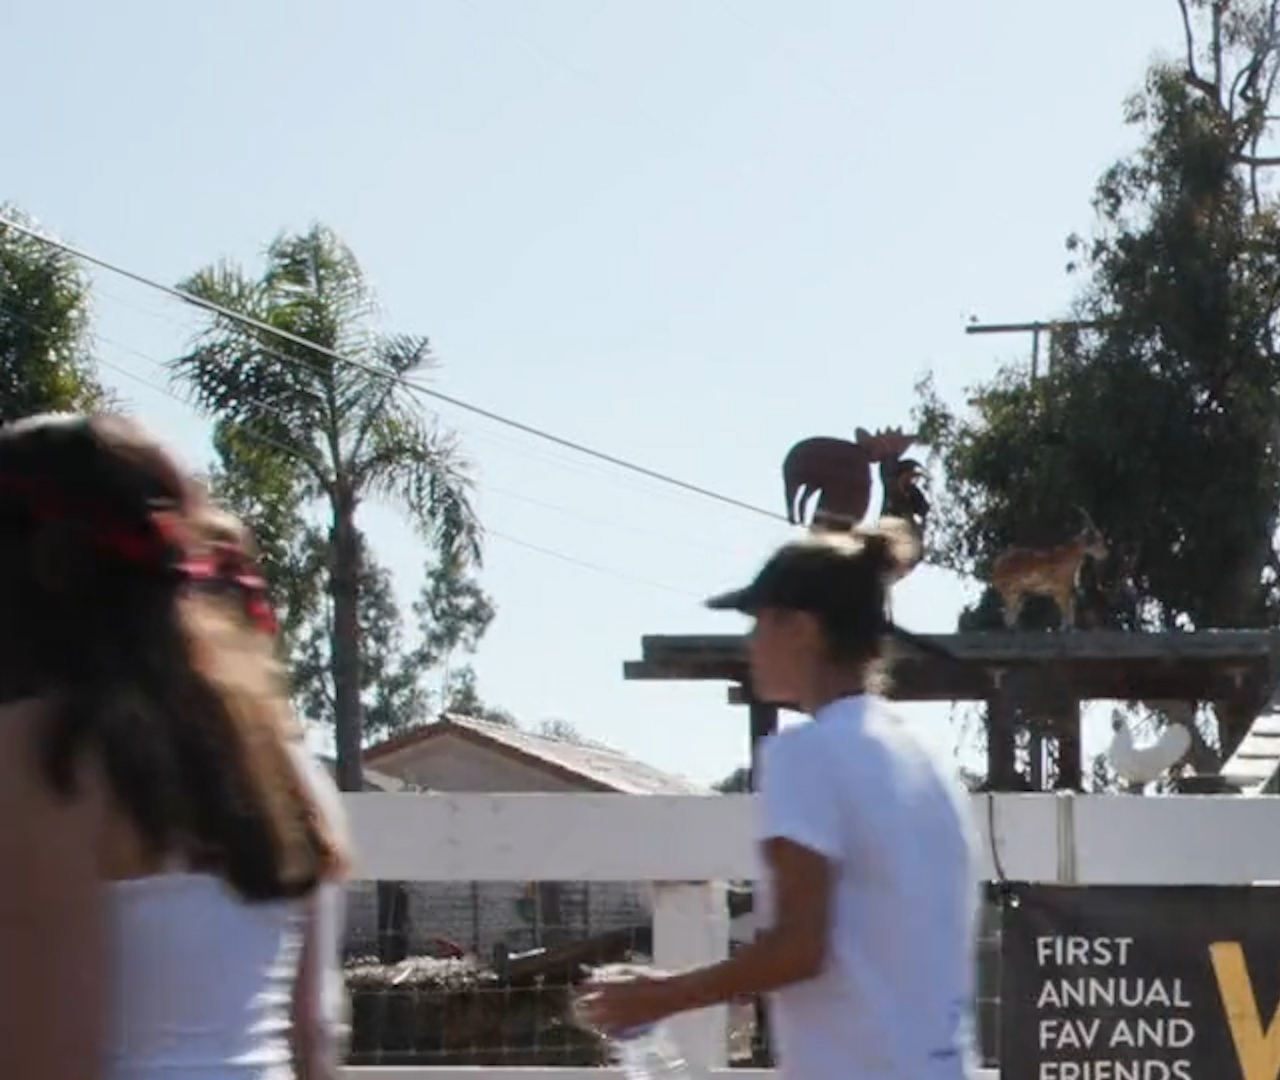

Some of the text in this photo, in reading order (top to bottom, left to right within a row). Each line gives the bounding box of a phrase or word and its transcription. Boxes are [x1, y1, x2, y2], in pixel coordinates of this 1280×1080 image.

[1036, 936, 1134, 966] FIRST
[1036, 978, 1191, 1009] ANNUAL
[1039, 1018, 1195, 1050] FAV AND
